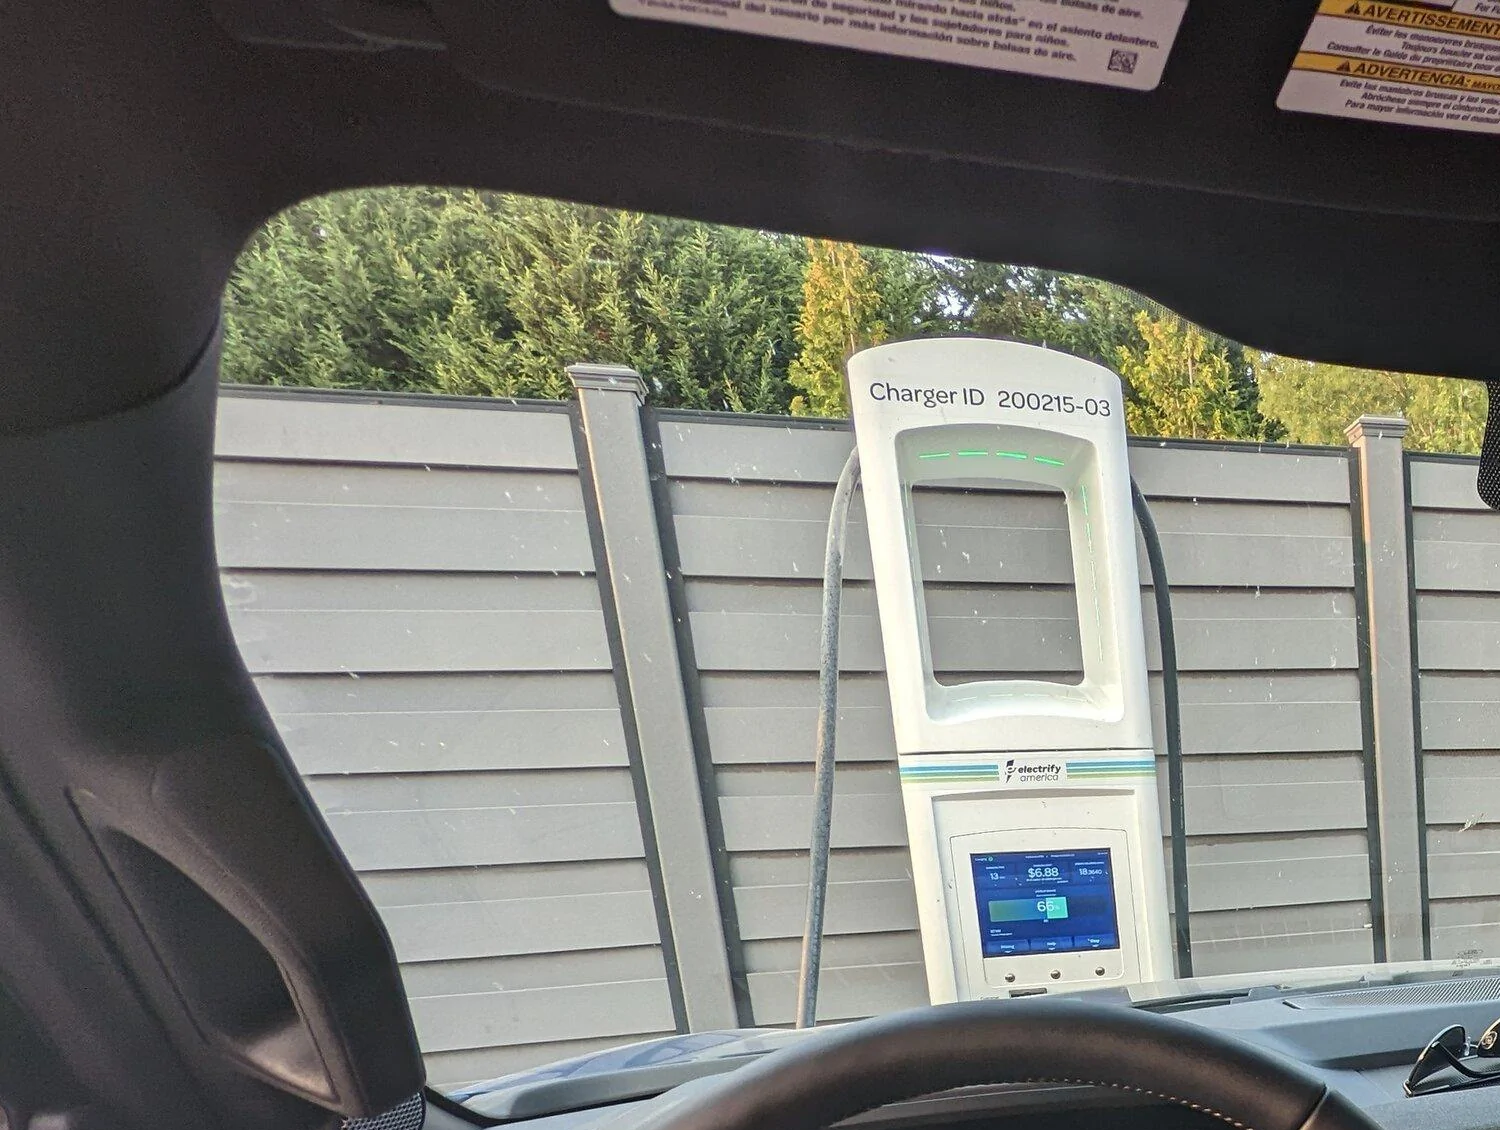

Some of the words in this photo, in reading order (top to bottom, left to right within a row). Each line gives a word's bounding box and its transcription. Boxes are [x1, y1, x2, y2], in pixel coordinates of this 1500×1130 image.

[1060, 24, 1103, 39] asiento
[1353, 62, 1471, 88] ADVERTENCIA:
[869, 382, 957, 408] Charger
[964, 388, 985, 406] ID
[998, 390, 1111, 417] 200215-03
[1018, 763, 1061, 776] electrify
[1020, 773, 1059, 783] america
[1028, 867, 1059, 878] $6.88
